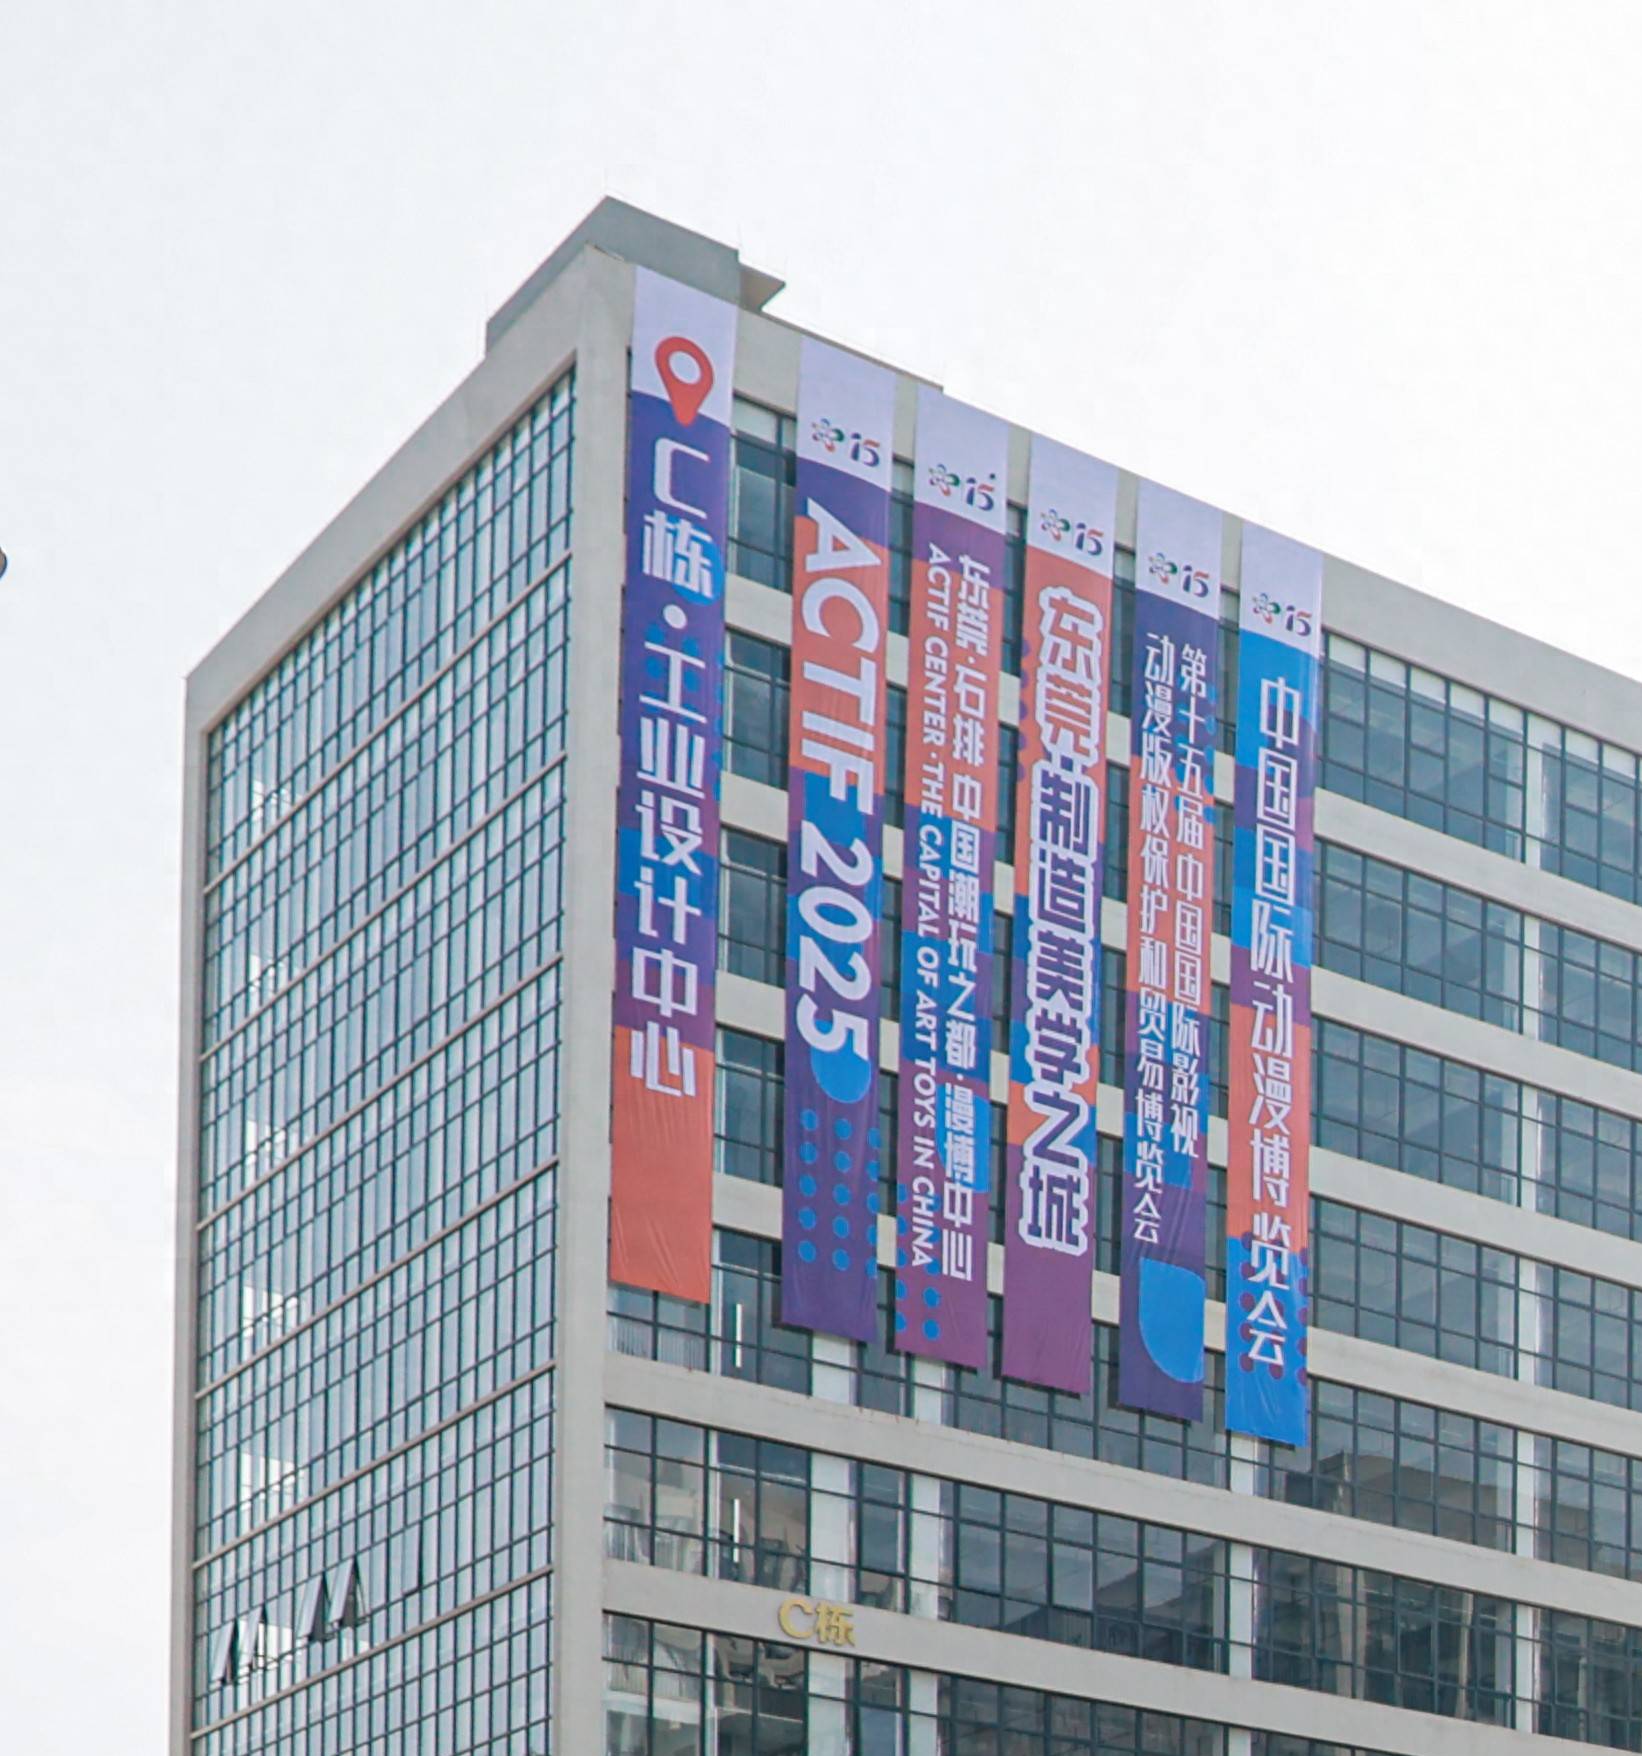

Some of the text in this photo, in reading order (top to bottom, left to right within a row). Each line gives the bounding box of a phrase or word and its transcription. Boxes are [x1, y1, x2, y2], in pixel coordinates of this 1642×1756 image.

[630, 437, 713, 1099] C栋·工业设计中心
[796, 497, 883, 1061] ACTIF 2025
[910, 542, 951, 1268] ACTIF CENTER THE CAPITAL OF ART TOYS IN CHINA
[1246, 676, 1301, 1366] 中国国际动漫博览会
[777, 1598, 856, 1648] C栋
